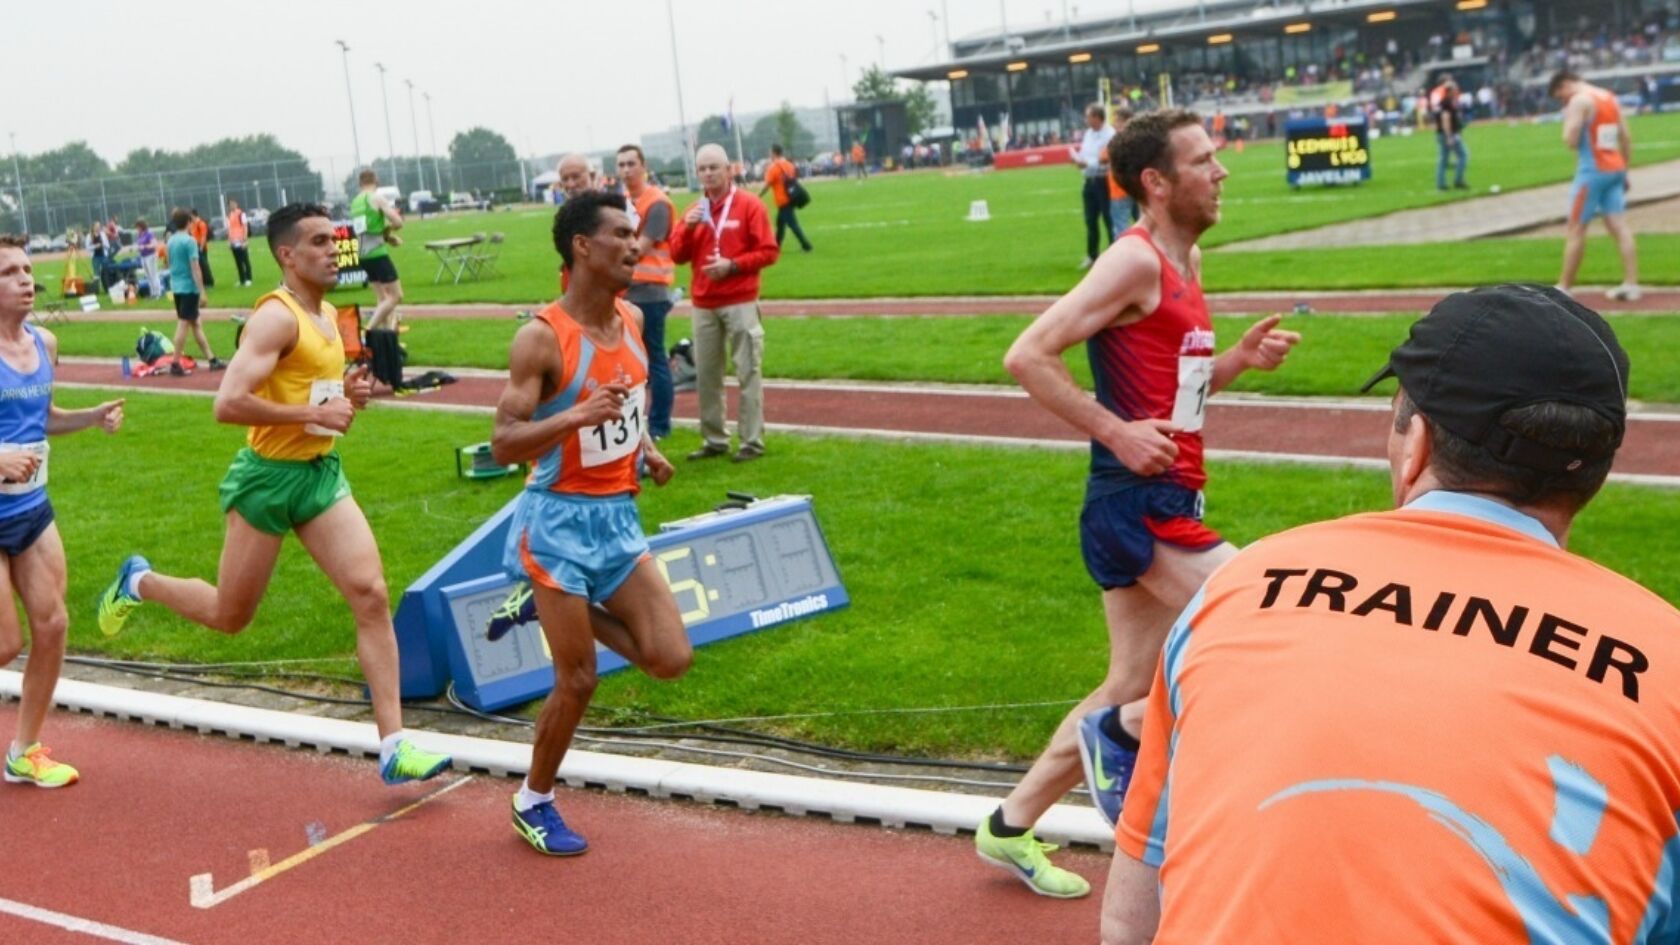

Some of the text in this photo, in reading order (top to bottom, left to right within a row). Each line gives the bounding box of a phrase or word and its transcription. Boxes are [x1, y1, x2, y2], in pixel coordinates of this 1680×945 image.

[1297, 168, 1360, 186] JAVELIN
[592, 406, 640, 451] 131
[750, 594, 829, 628] TimeTronics
[1260, 568, 1649, 703] TRAINER
